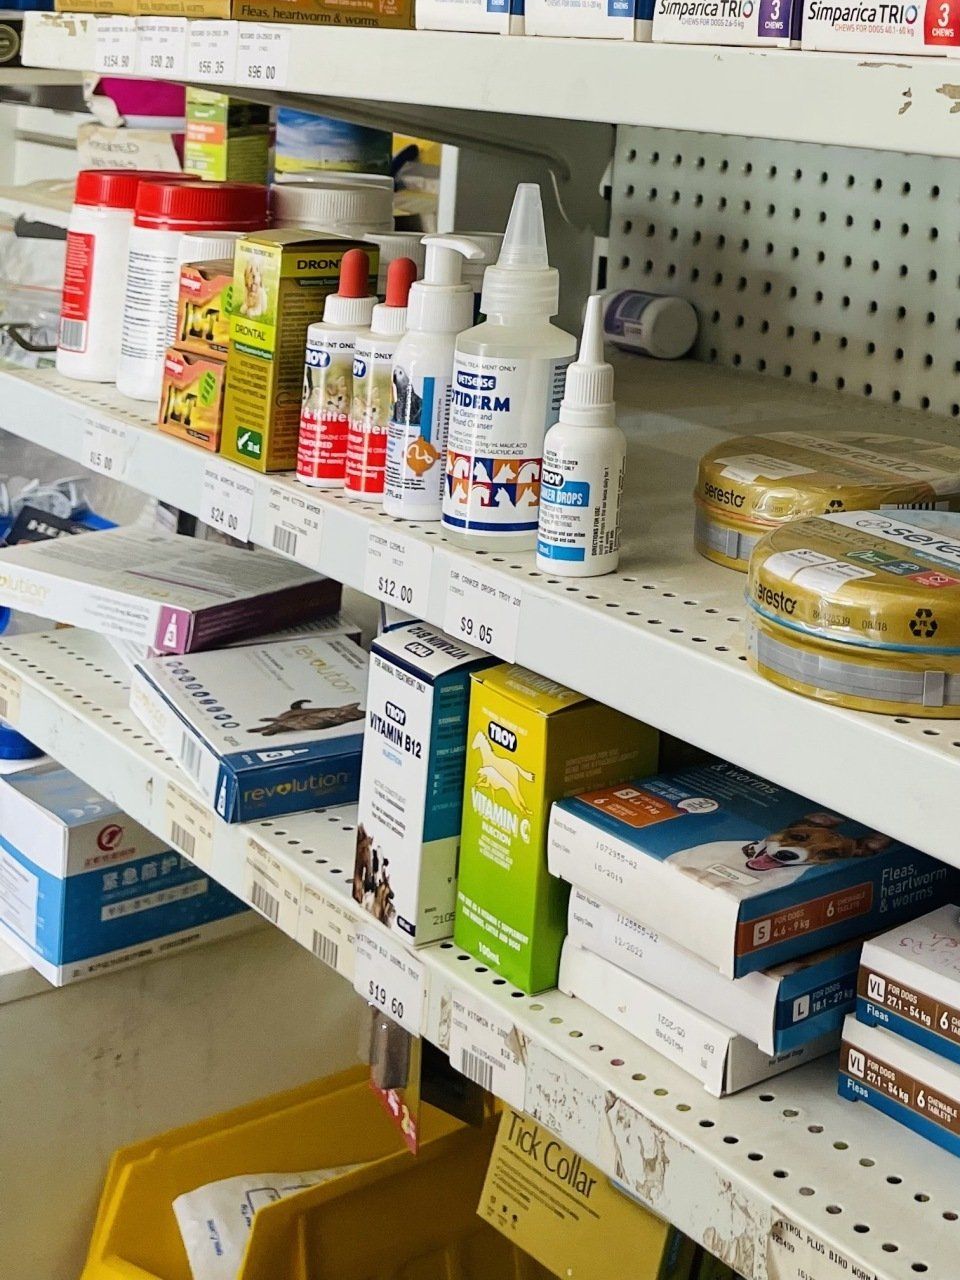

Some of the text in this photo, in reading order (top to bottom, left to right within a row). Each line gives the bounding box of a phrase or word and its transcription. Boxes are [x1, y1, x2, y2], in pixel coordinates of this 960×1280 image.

[242, 5, 379, 26] Fleas, heartworm & worms
[235, 323, 266, 341] DRONTAL
[557, 491, 582, 504] DROPS
[704, 482, 746, 509] seresto
[379, 577, 413, 604] $12.00
[460, 617, 493, 644] $9.05
[387, 703, 405, 724] TROY
[370, 711, 422, 759] VITAMIN B12
[489, 722, 516, 750] TROY
[243, 770, 348, 802] revolution
[471, 786, 530, 844] VITAMIN C
[880, 868, 947, 899] heartworm
[881, 863, 918, 884] Fleas,
[869, 978, 883, 998] VL
[866, 1004, 889, 1023] Fleas
[940, 1010, 950, 1030] 6
[507, 1111, 597, 1199] Tick Collar
[807, 1236, 825, 1255] PLUS
[829, 1250, 847, 1269] BIRD
